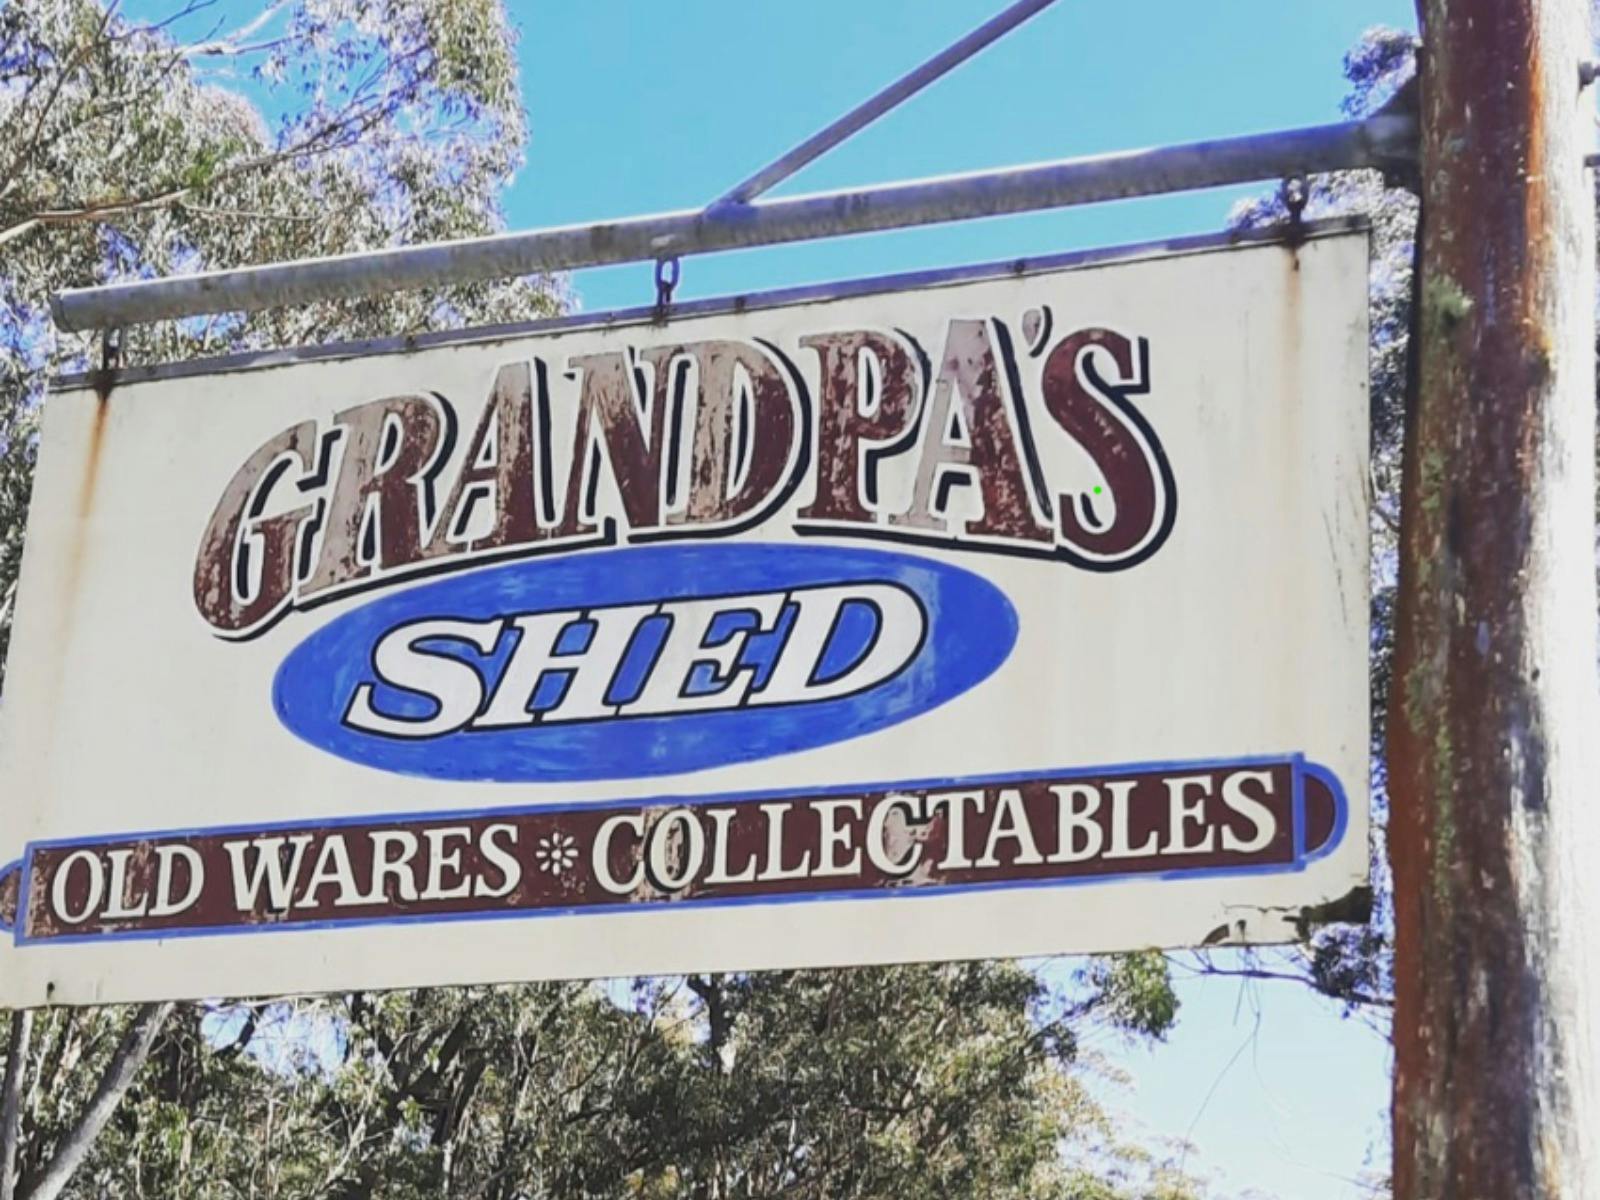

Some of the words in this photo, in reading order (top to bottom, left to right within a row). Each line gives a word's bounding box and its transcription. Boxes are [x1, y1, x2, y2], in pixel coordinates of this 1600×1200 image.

[193, 305, 1178, 642] GRANDPA'S
[345, 583, 926, 738] SHED
[51, 844, 205, 924] OLD
[223, 823, 522, 912] WARES
[591, 770, 1277, 896] COLLECTABLES
